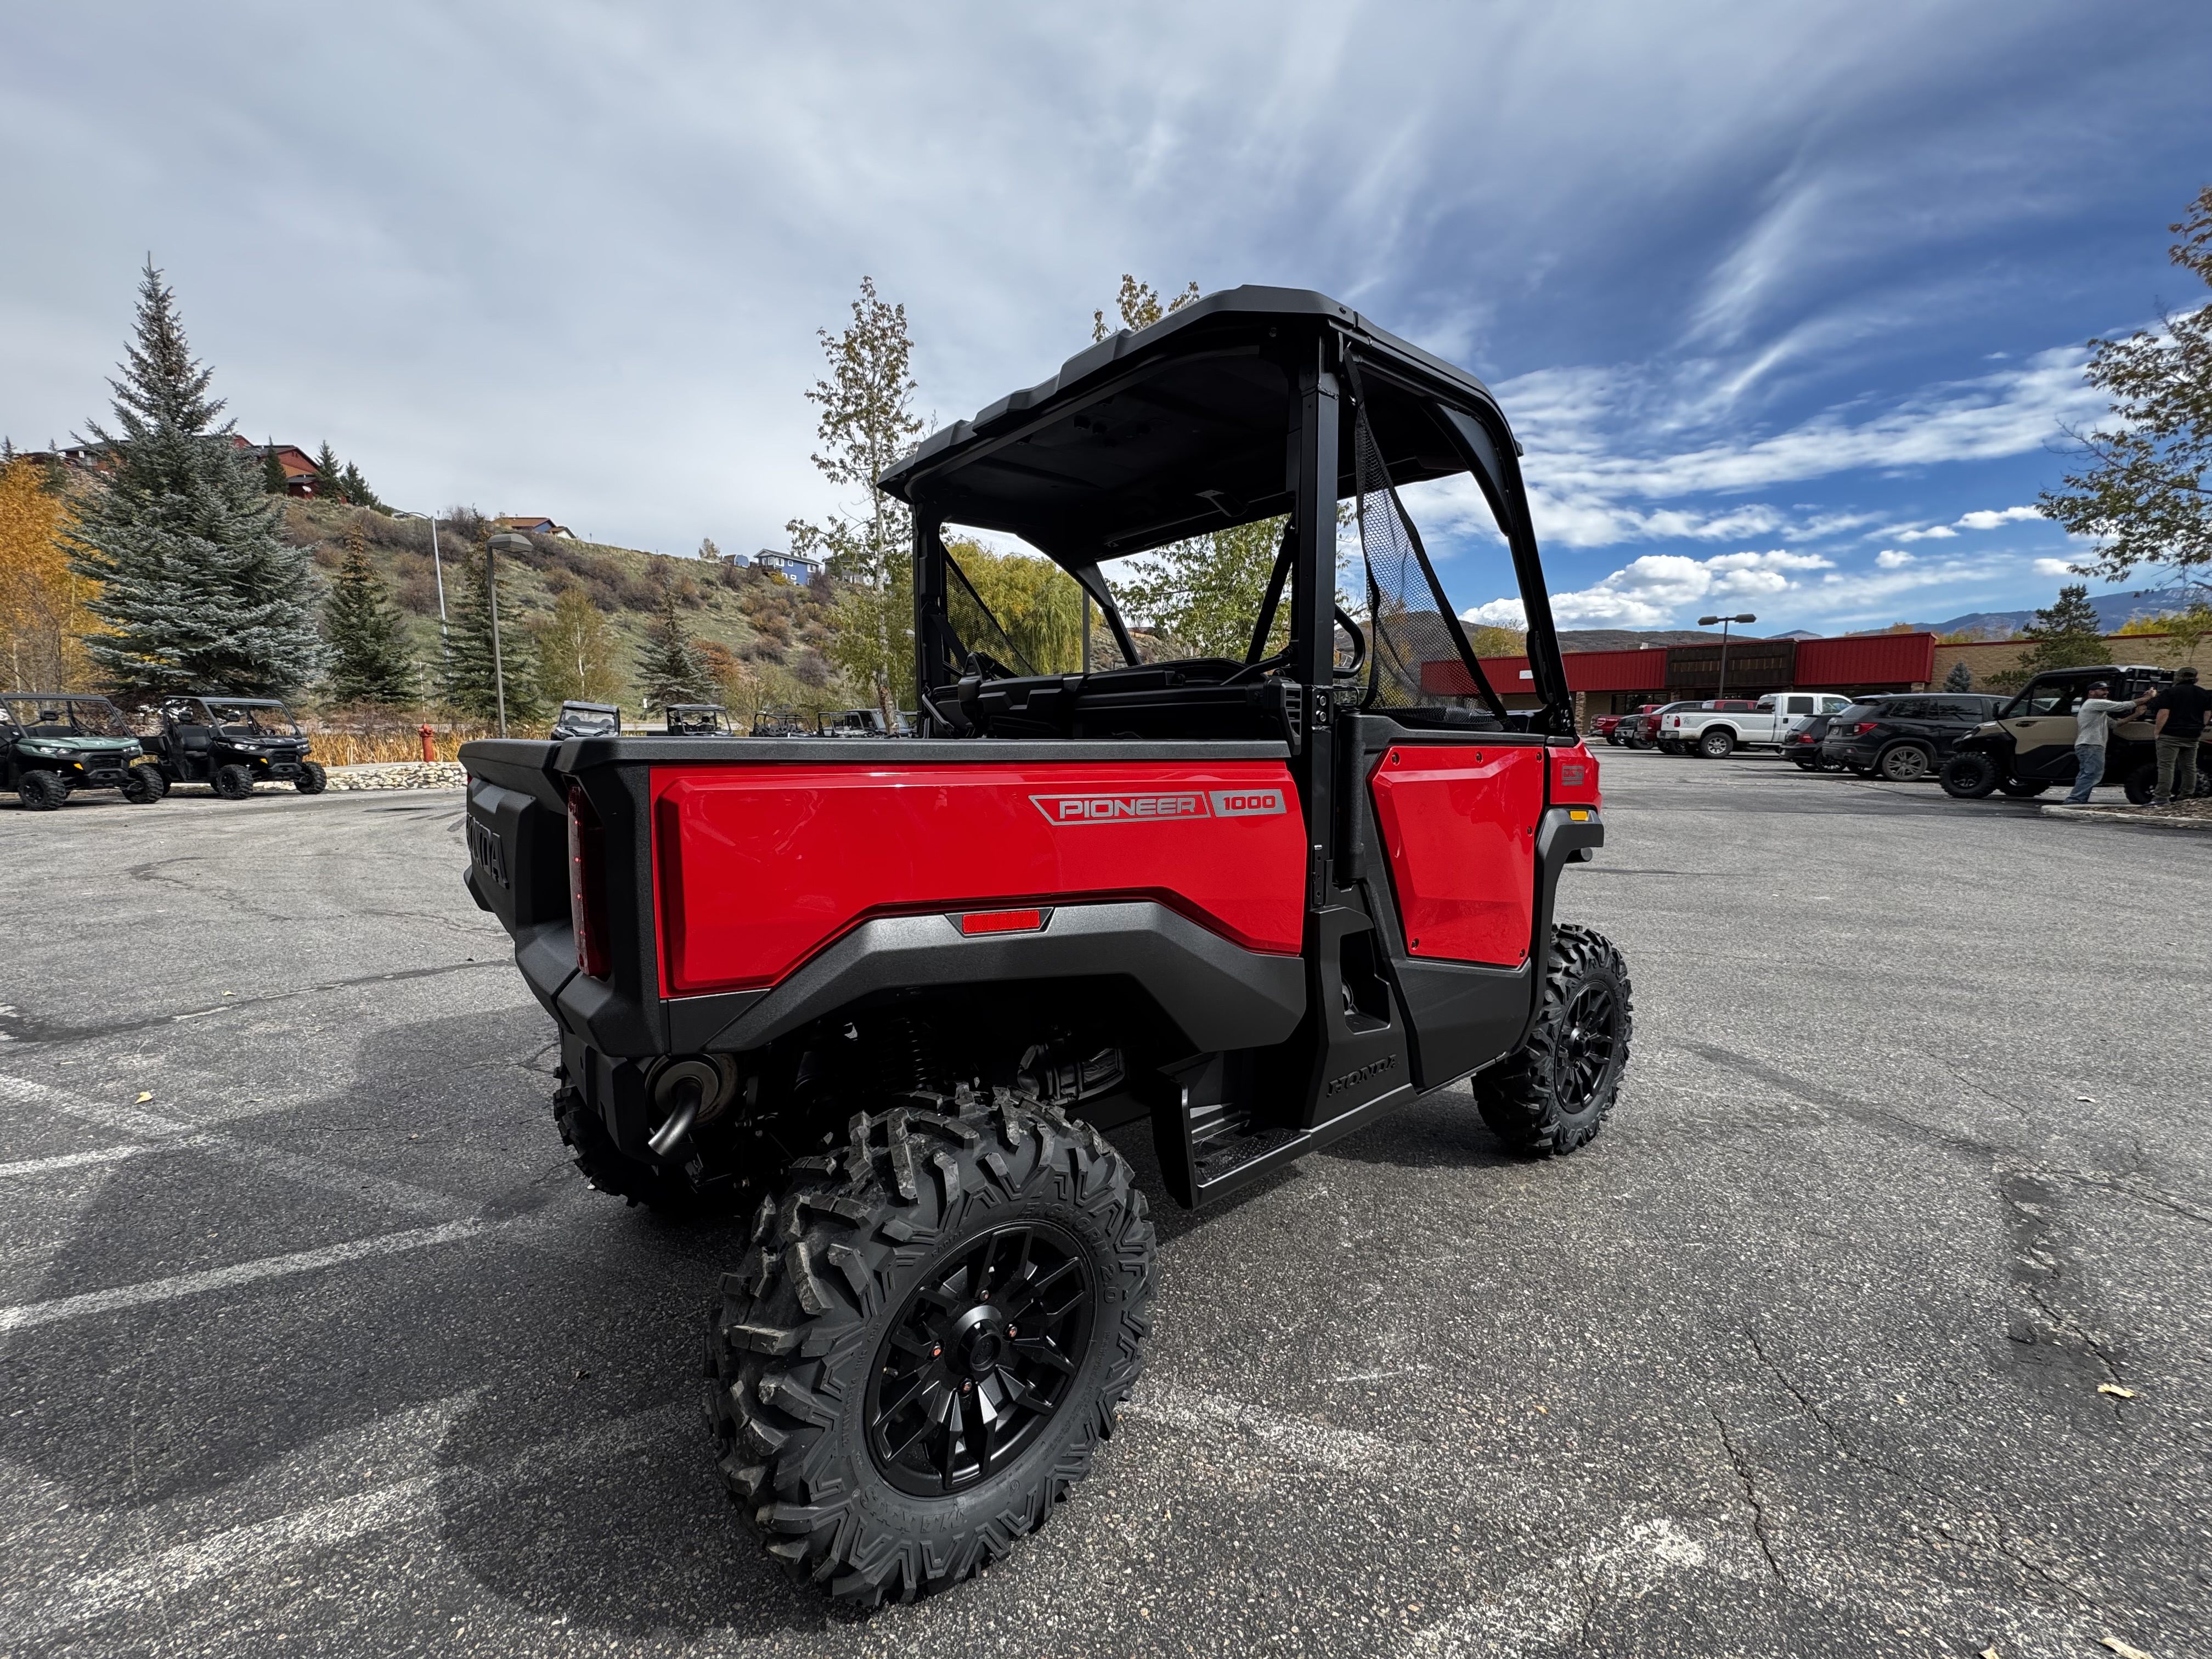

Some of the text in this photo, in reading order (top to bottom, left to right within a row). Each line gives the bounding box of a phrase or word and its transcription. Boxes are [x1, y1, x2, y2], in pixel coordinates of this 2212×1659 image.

[1059, 795, 1276, 819] PIONEER 1000
[1327, 1054, 1397, 1097] HONDA
[1100, 1264, 1119, 1304] 2.0
